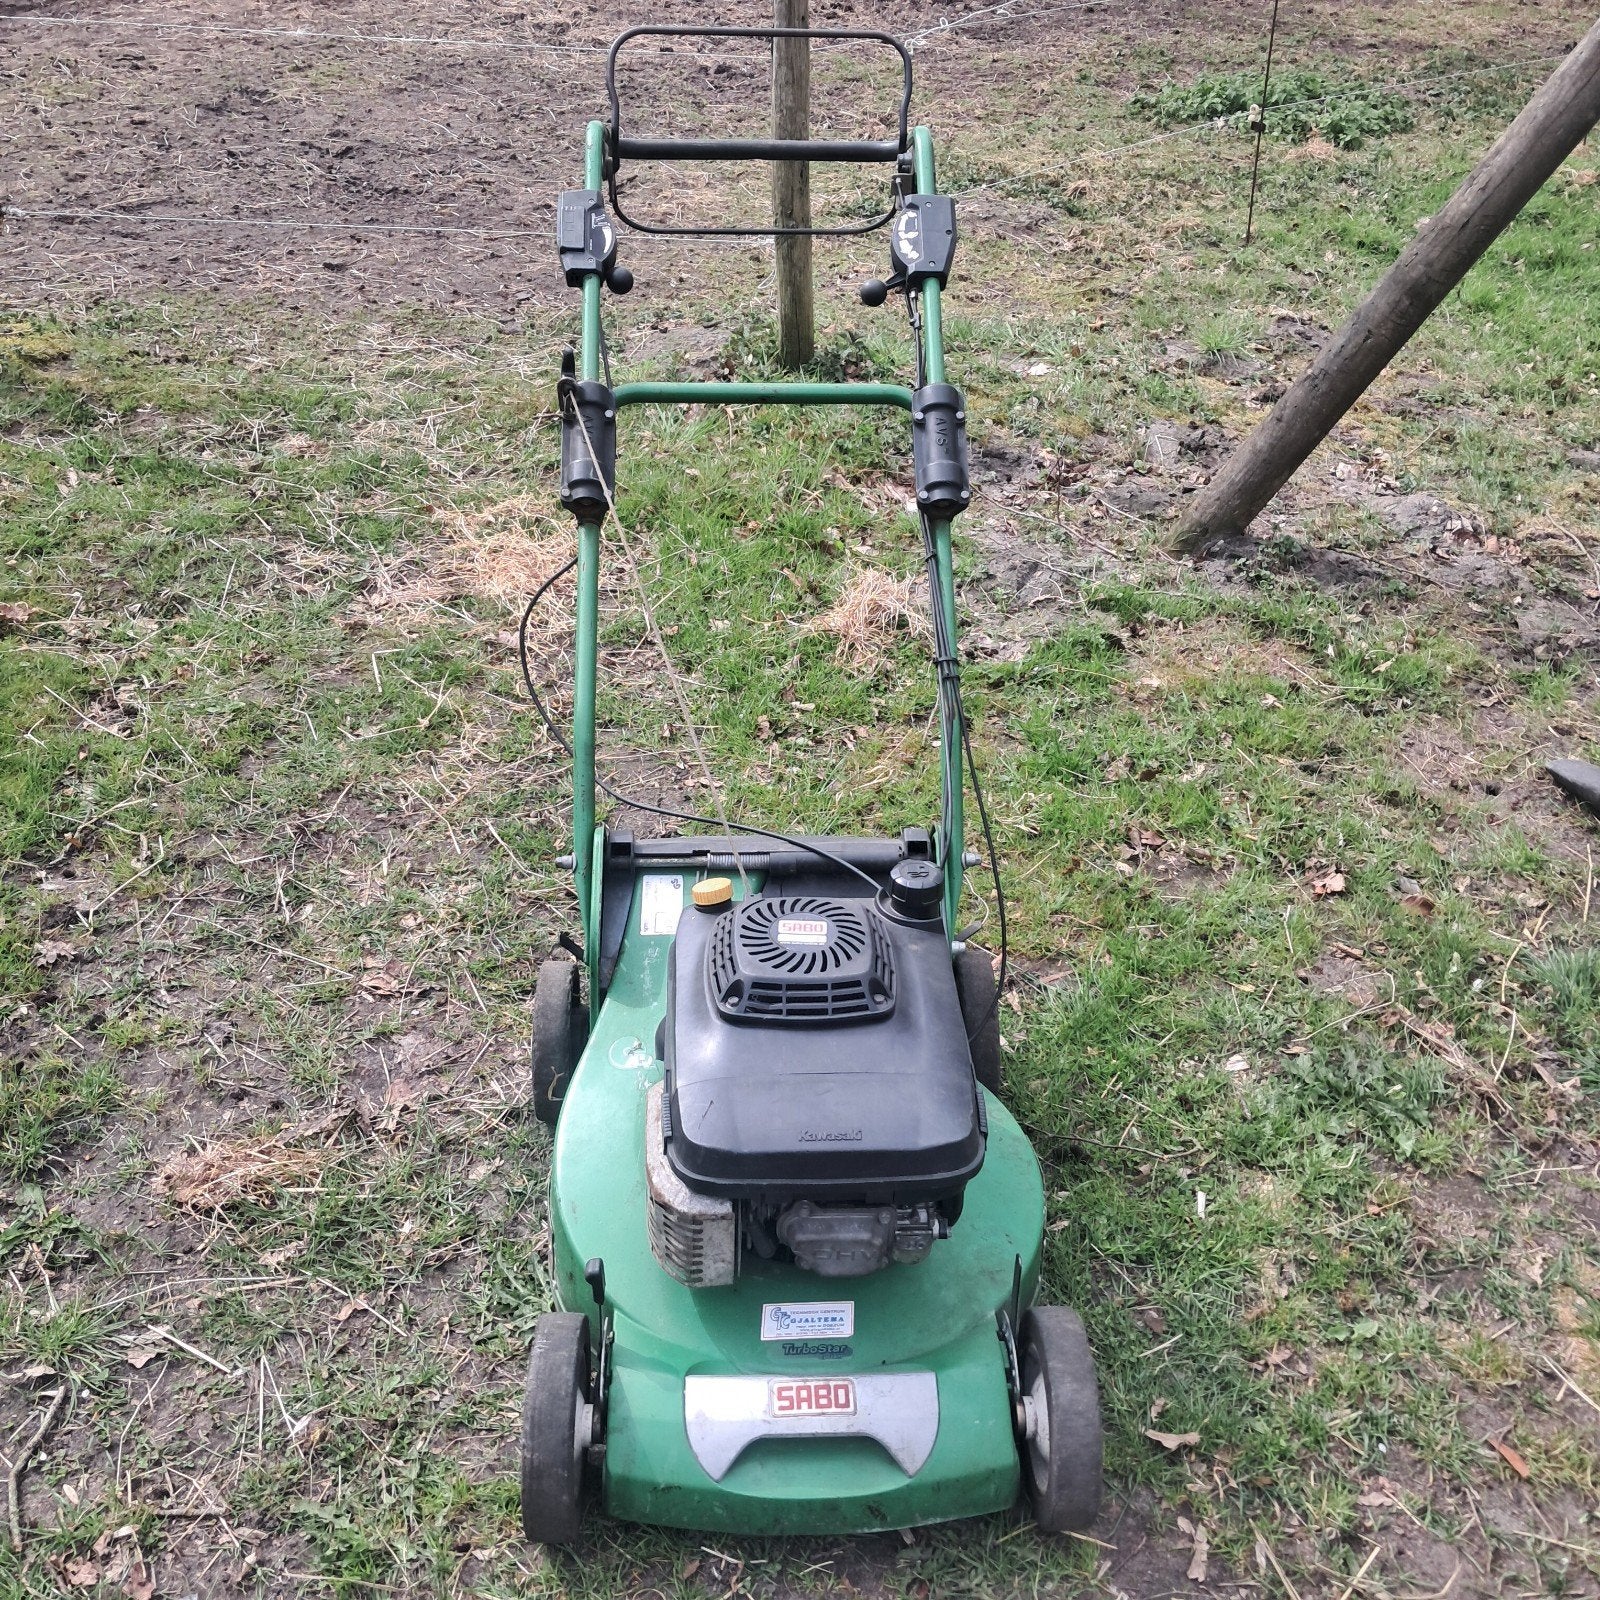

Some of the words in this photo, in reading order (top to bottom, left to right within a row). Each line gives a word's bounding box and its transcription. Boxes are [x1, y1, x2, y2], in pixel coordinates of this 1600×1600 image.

[782, 922, 824, 933] SABO
[799, 1128, 863, 1142] Kawasaki
[782, 1344, 848, 1355] TurboStar
[777, 1384, 850, 1411] SABO
